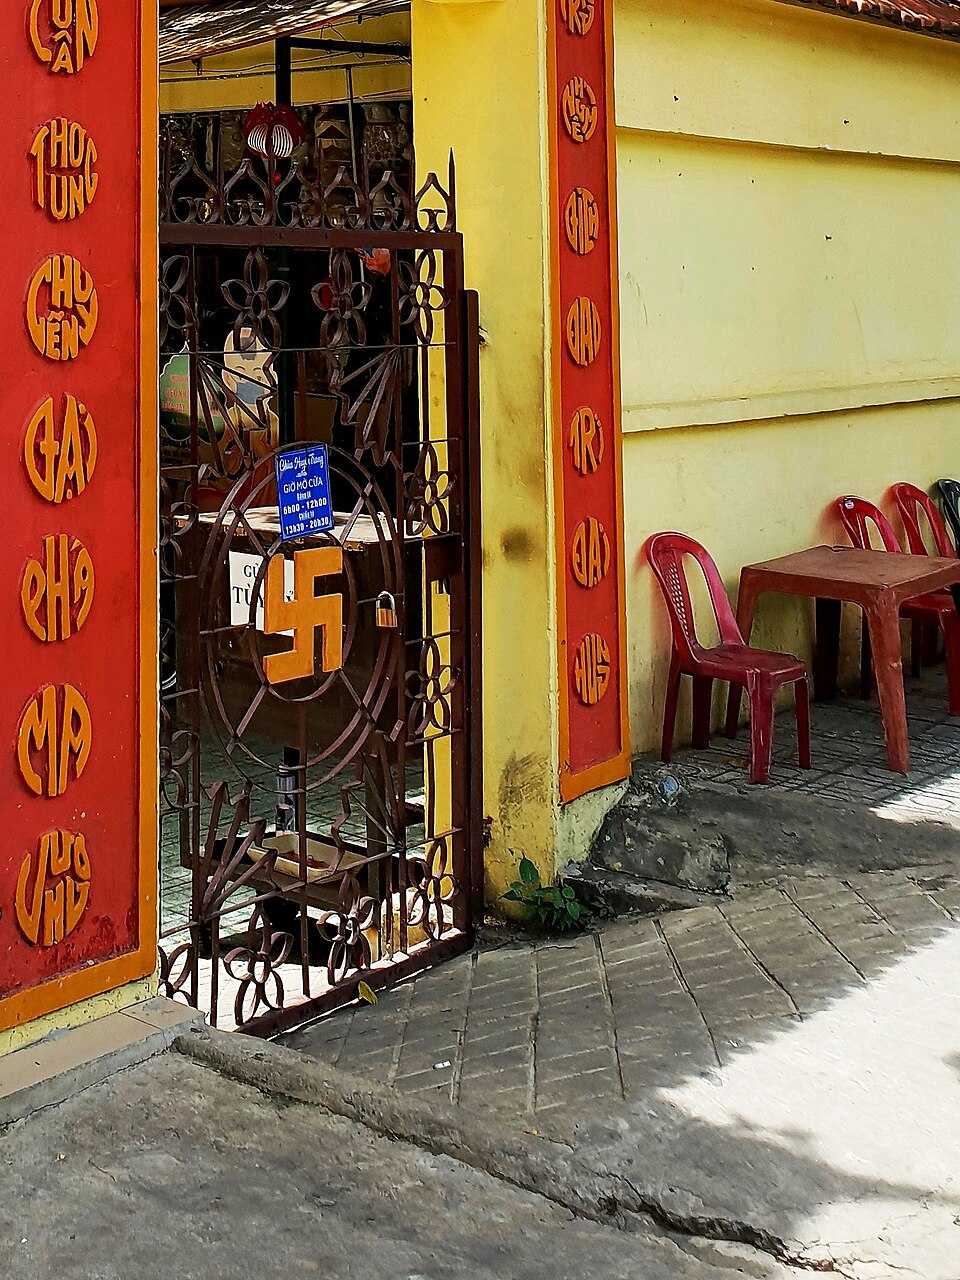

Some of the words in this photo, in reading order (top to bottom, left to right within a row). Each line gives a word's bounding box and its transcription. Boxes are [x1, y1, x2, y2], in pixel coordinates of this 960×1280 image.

[25, 393, 98, 504] ĐẠI
[285, 523, 305, 535] 13h30
[309, 516, 329, 529] 20h30
[306, 497, 327, 510] 12h00
[21, 534, 96, 642] PHÁ
[17, 681, 93, 797] MA
